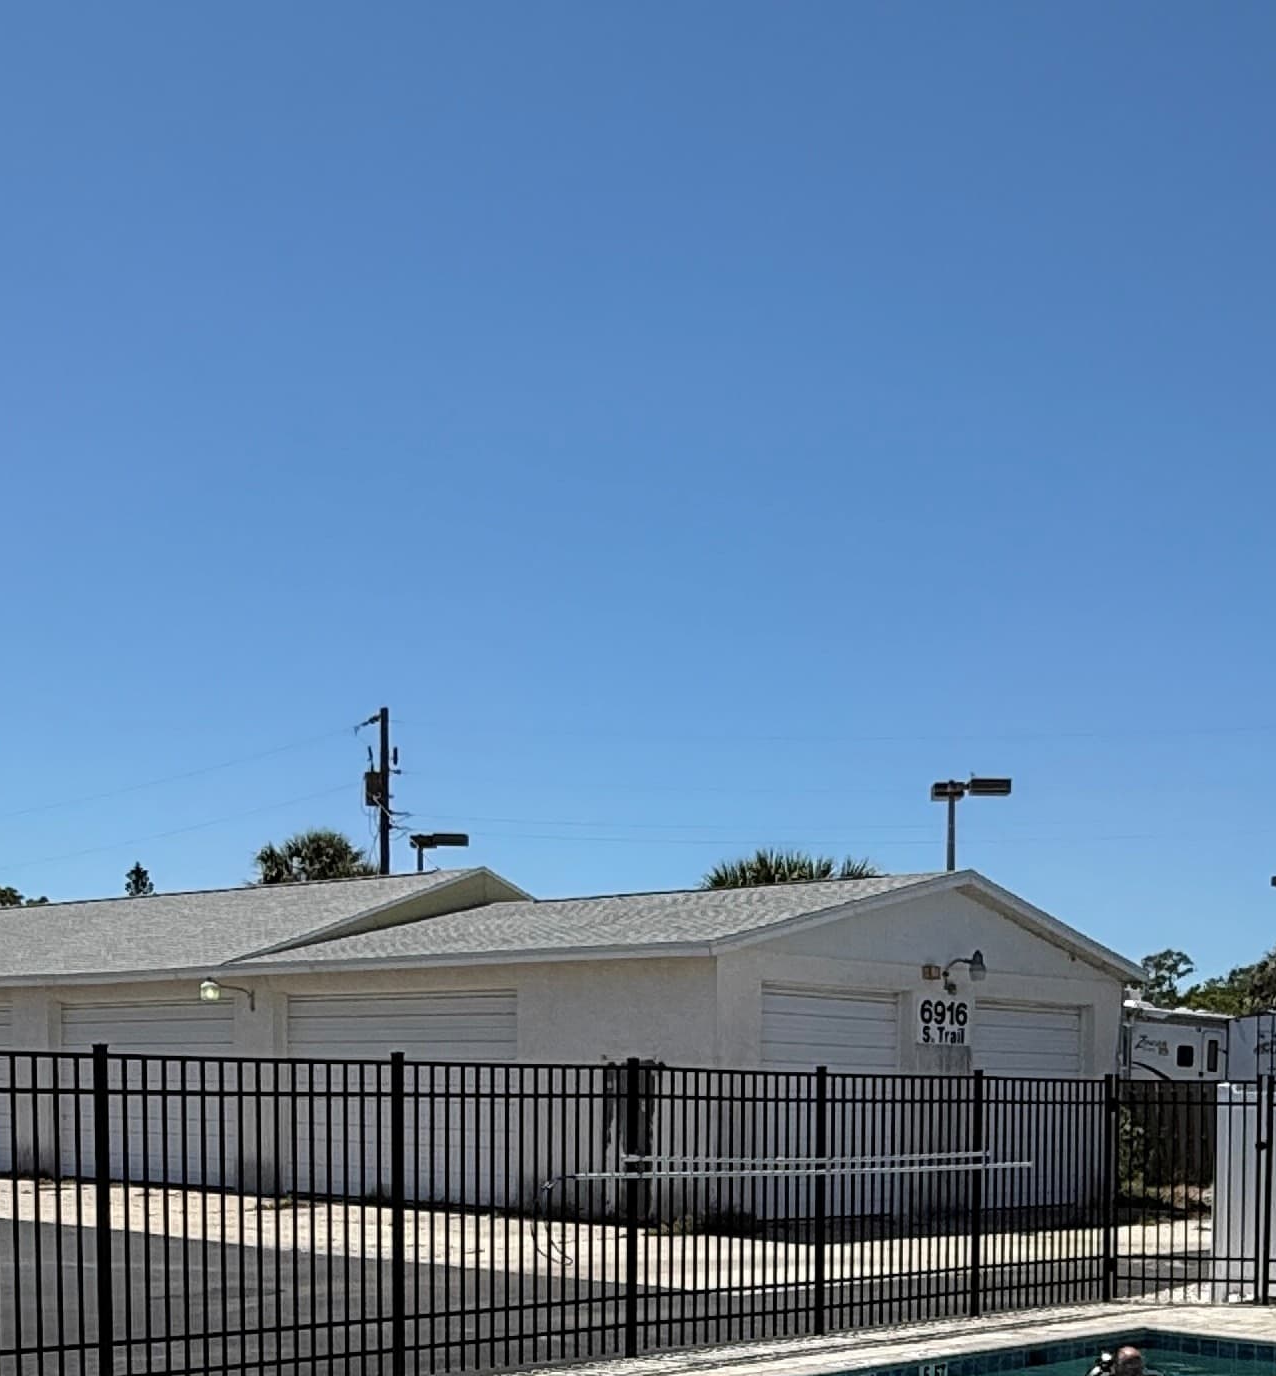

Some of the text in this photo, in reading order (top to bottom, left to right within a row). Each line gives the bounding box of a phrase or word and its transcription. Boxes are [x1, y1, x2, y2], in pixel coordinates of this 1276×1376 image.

[920, 999, 968, 1026] 6916
[922, 1025, 966, 1044] S. Trail
